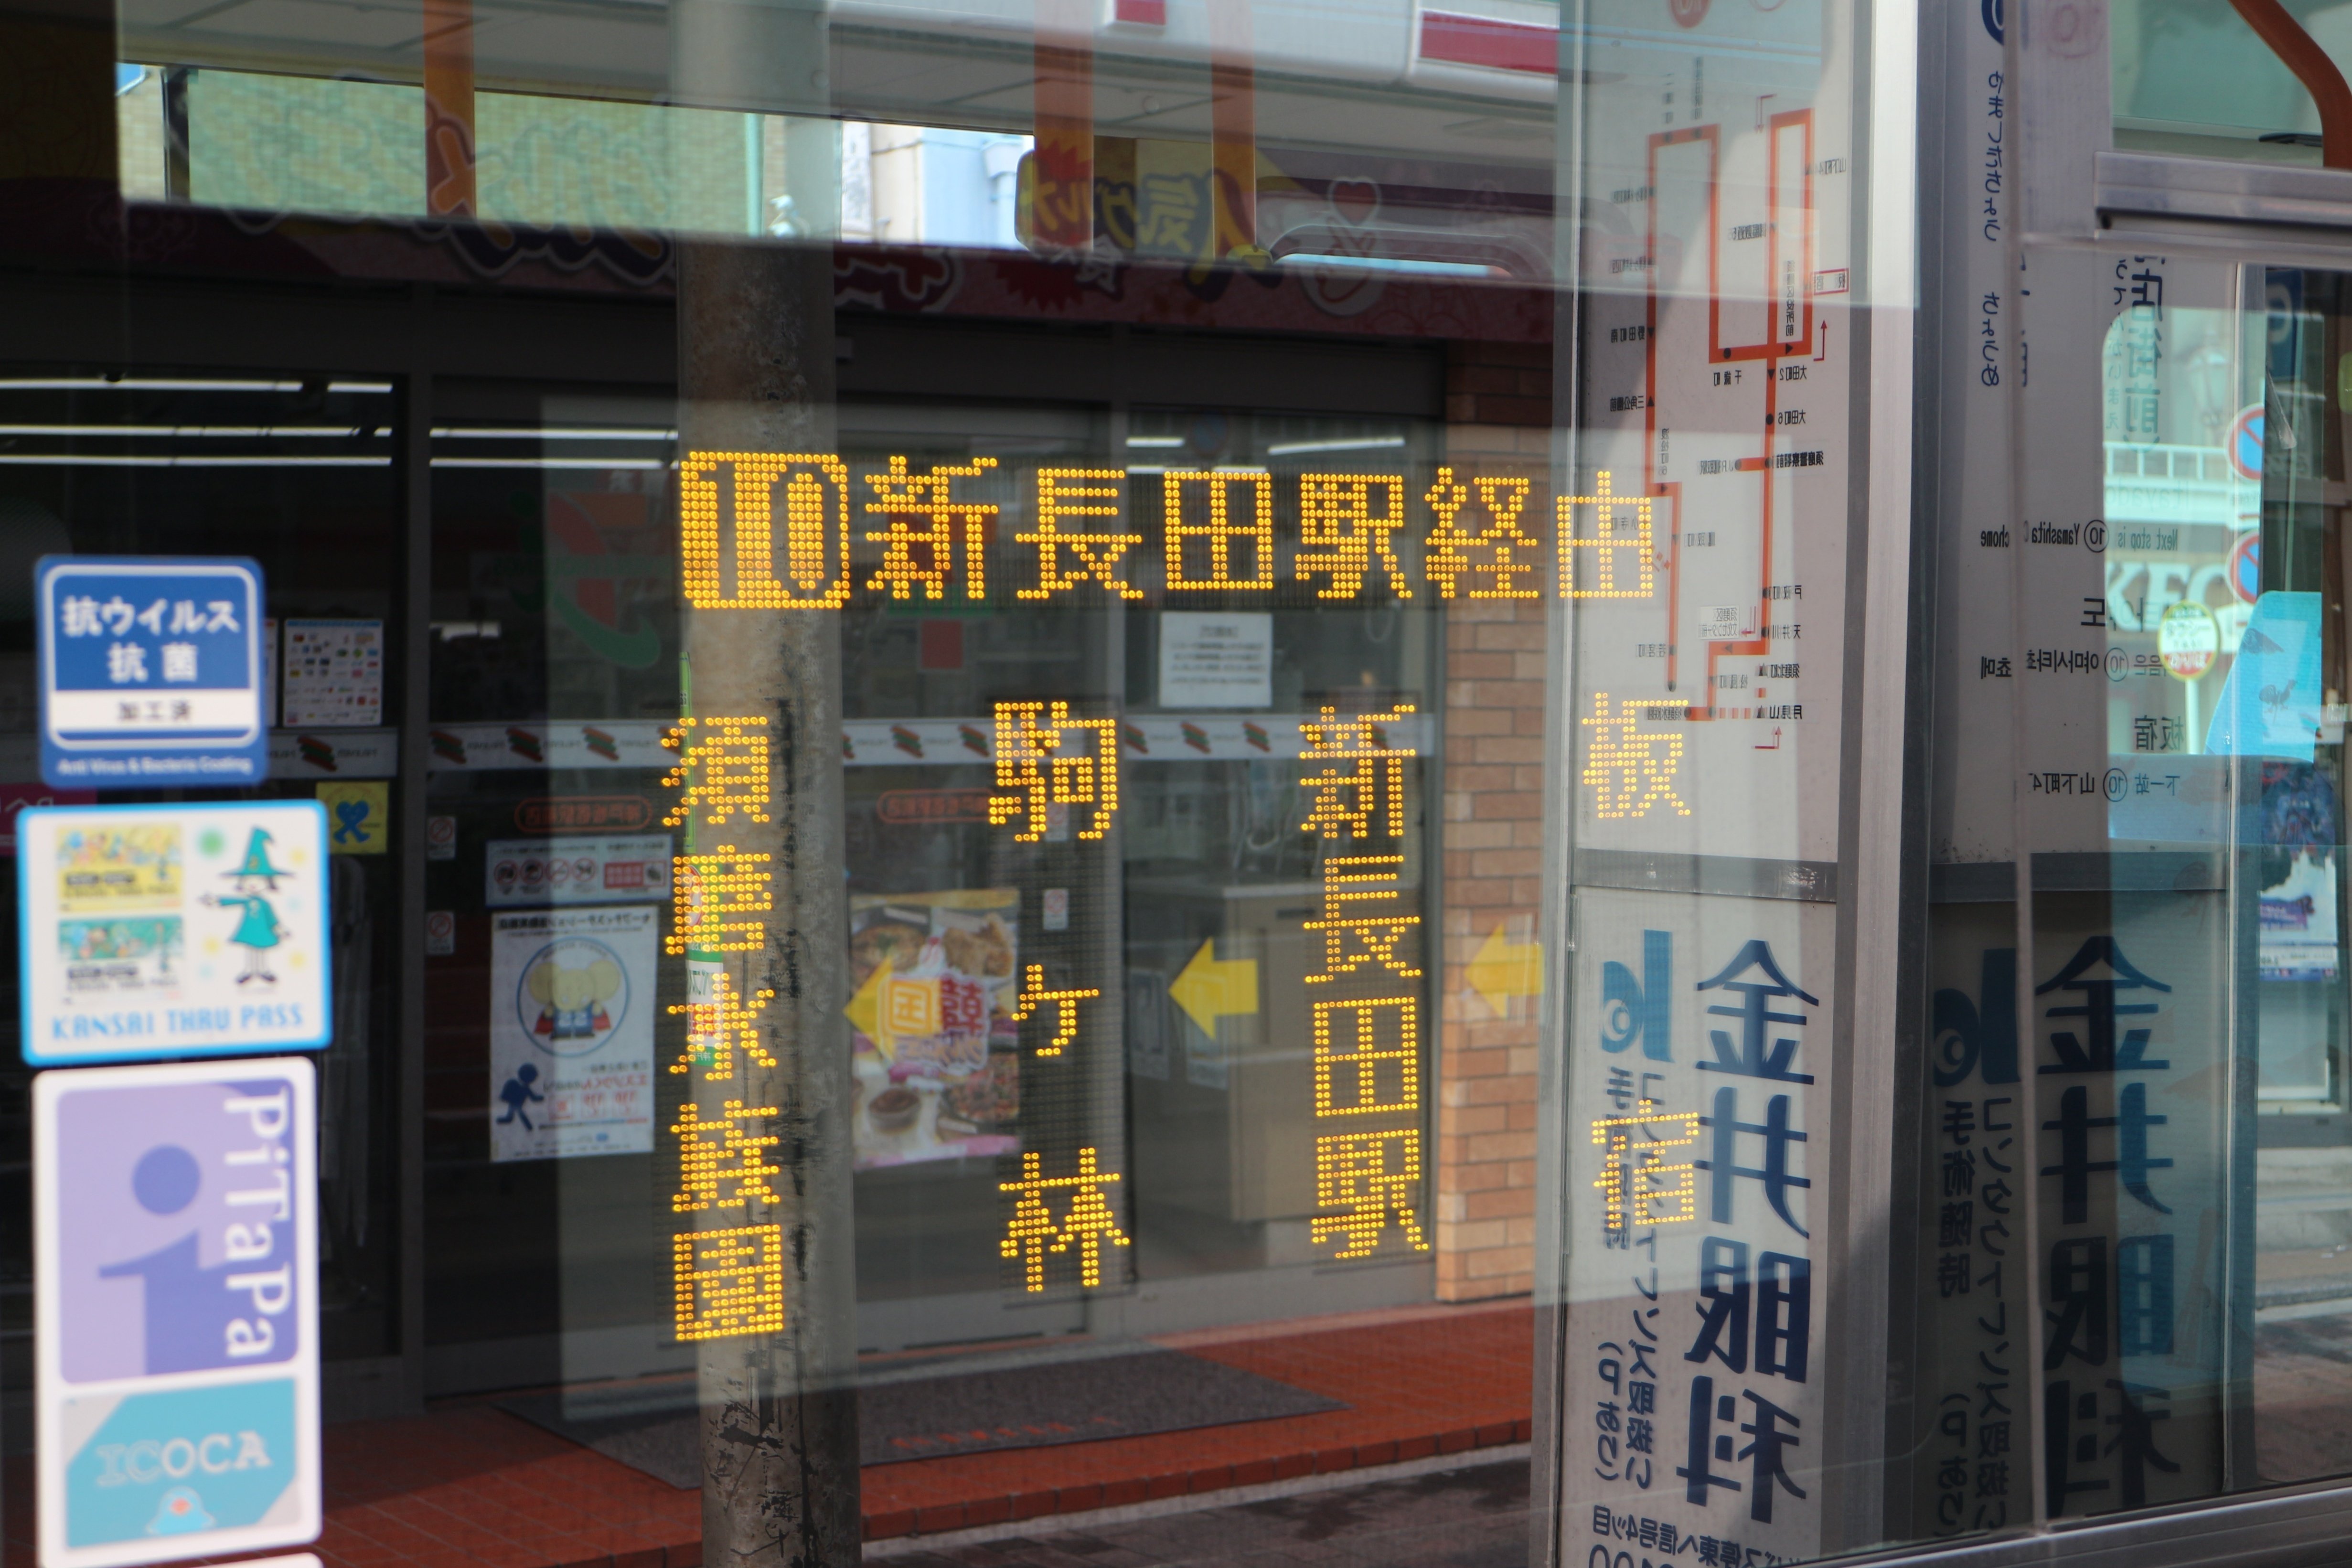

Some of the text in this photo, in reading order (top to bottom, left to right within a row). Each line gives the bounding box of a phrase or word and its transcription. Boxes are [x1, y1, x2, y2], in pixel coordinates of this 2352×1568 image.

[865, 456, 1654, 599] 新長田駅経由
[61, 595, 240, 637] 抗ウイルス
[52, 1003, 304, 1041] KANSAI THRU PASS
[1299, 704, 1429, 1259] 新長田駅
[224, 1087, 292, 1358] PiTaPa
[96, 1429, 273, 1487] ICOCA
